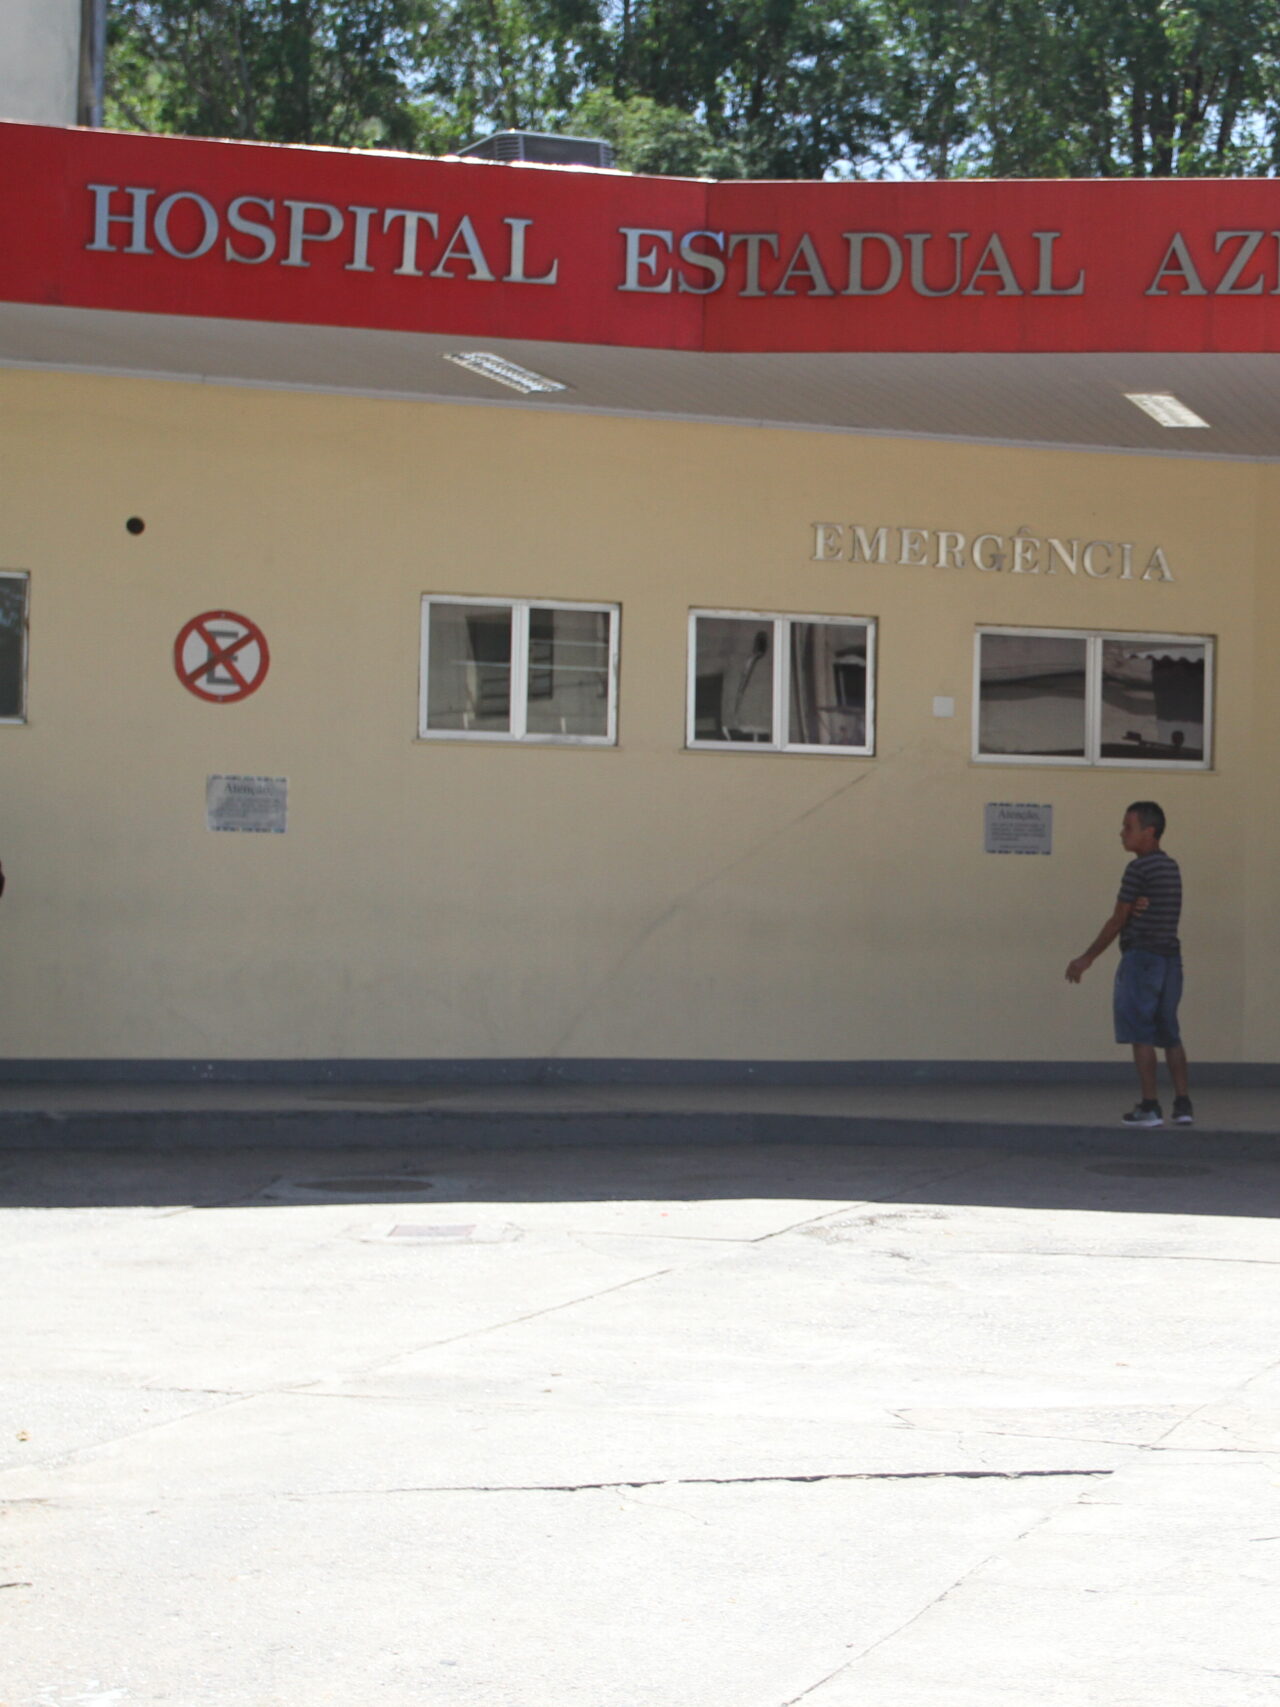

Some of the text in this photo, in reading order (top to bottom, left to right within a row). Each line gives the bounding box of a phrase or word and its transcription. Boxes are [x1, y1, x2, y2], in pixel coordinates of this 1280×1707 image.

[86, 182, 559, 286] HOSPITAL
[616, 226, 1086, 298] ESTADUAL
[809, 521, 1176, 582] EMERGÊNCIA
